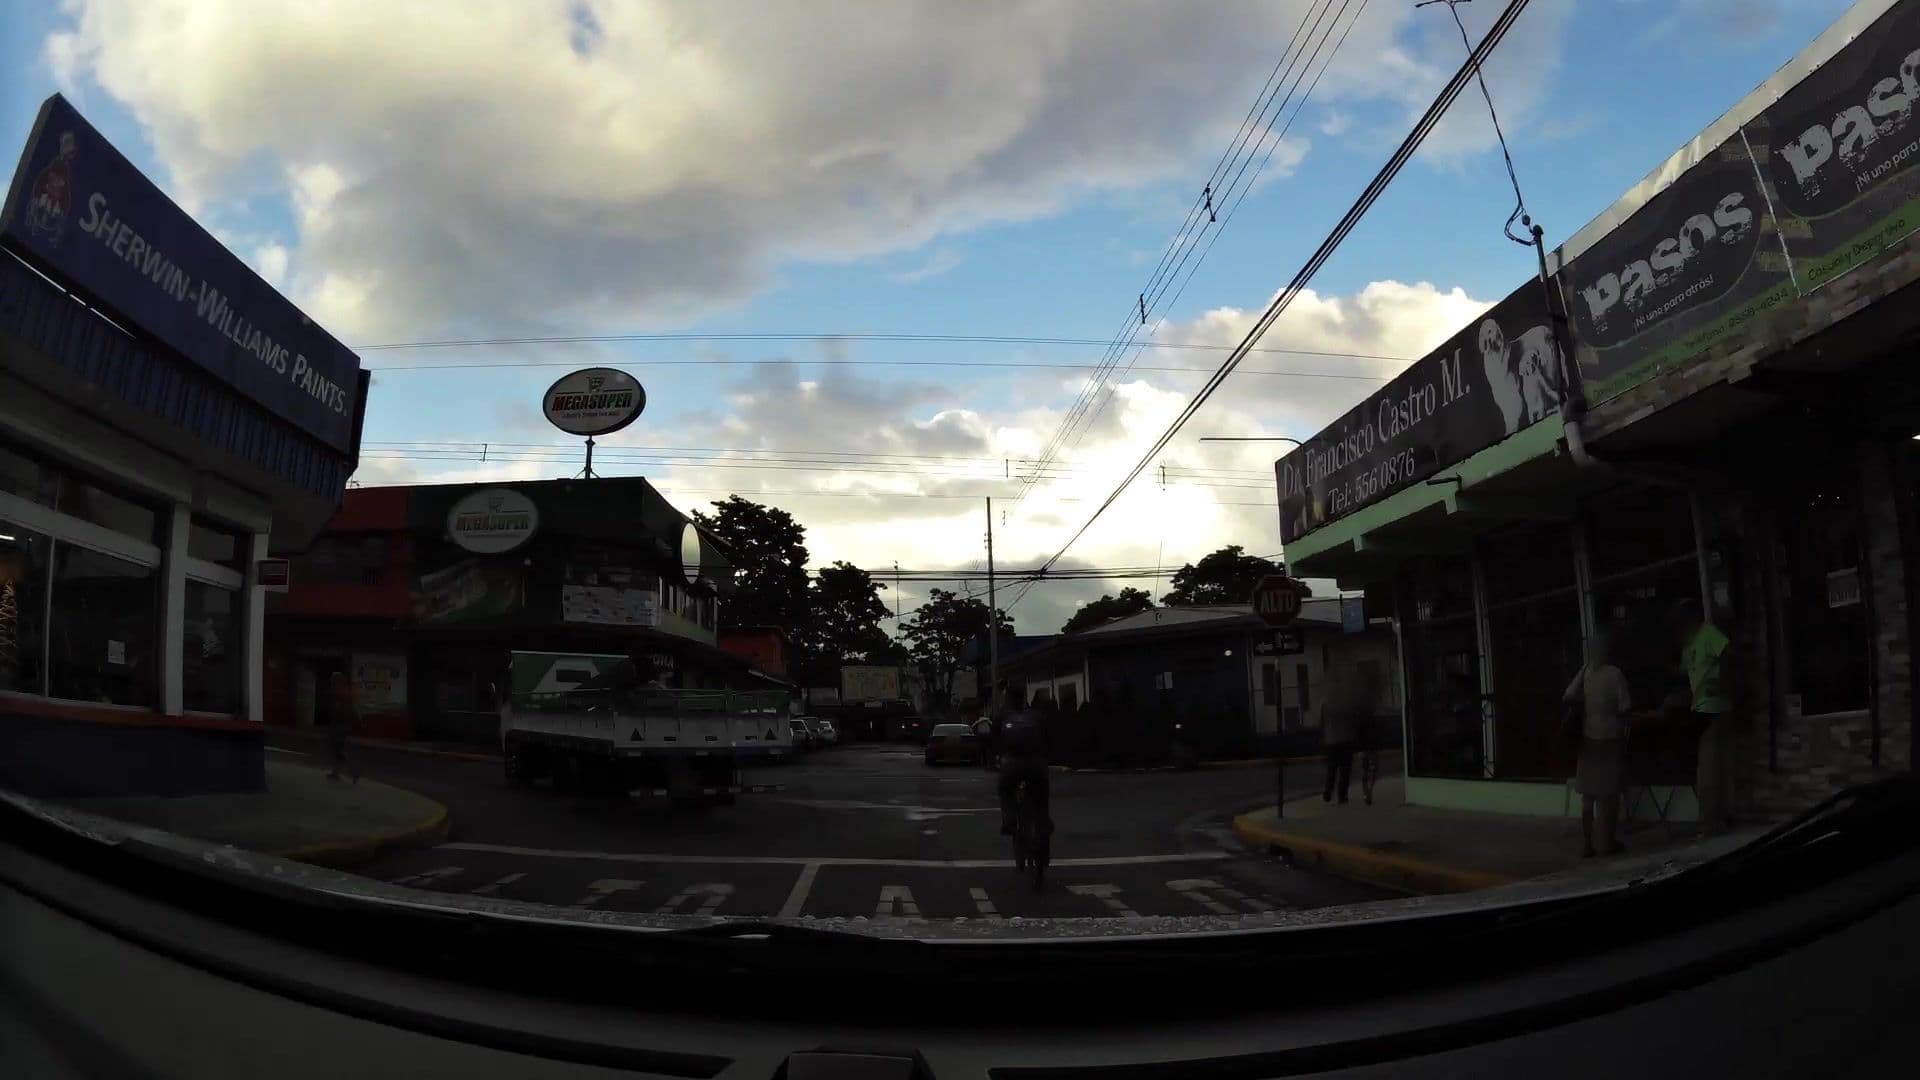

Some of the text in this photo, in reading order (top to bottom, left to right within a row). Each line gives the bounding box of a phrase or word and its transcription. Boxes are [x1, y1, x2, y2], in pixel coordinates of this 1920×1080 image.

[1871, 160, 1892, 178] uno
[1892, 141, 1918, 168] para
[1576, 192, 1752, 330] pasos
[552, 392, 633, 411] MEGASUPER
[1304, 422, 1374, 488] Francisco
[1377, 383, 1436, 443] Castro
[1440, 347, 1471, 407] M.
[1354, 466, 1378, 503] 556
[1379, 448, 1416, 493] 0876
[1260, 590, 1296, 613] ALTO
